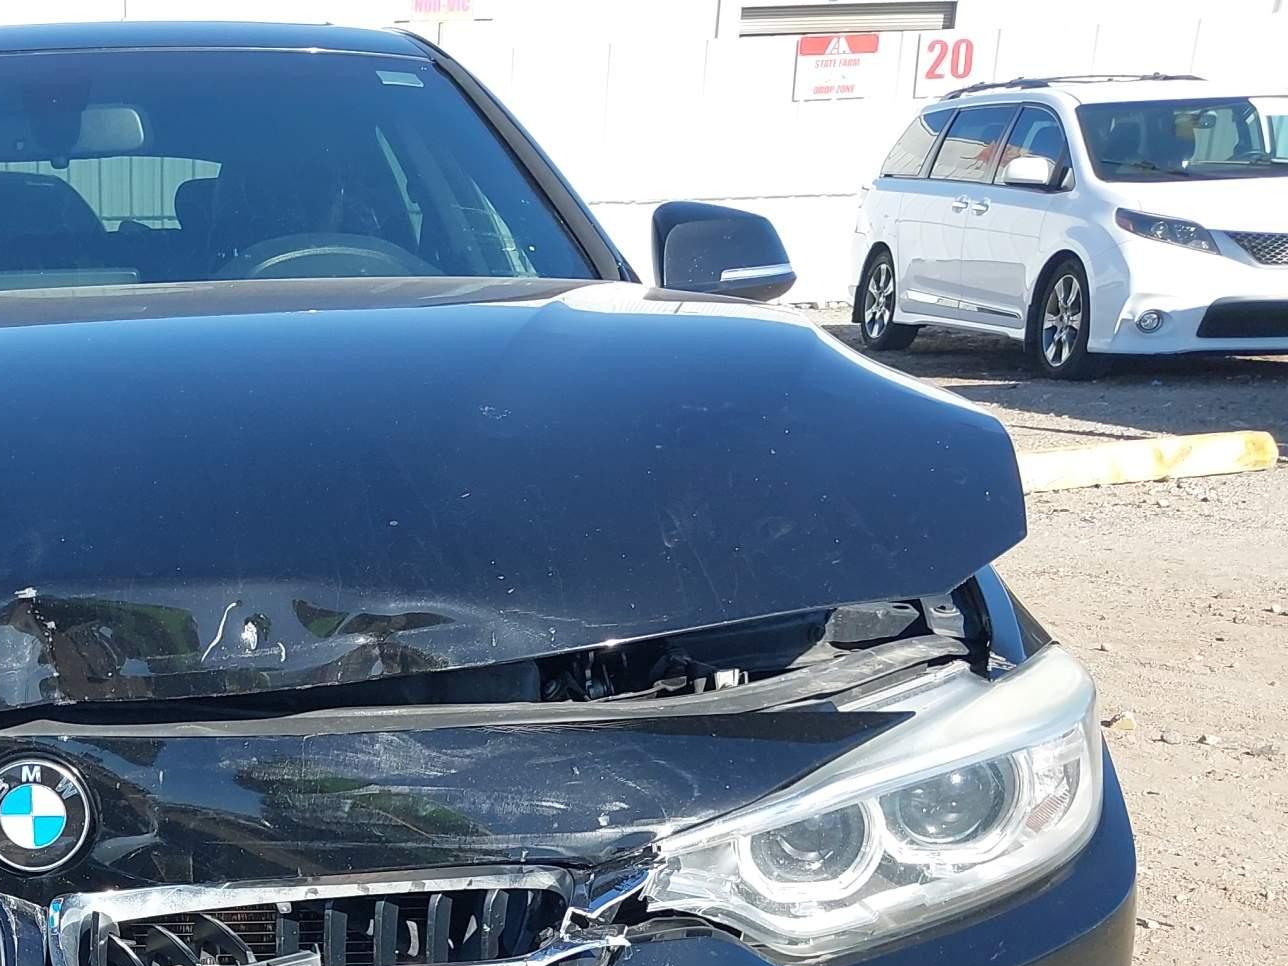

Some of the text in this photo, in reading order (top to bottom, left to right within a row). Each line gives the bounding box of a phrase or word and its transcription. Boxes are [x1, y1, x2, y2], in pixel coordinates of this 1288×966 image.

[925, 38, 974, 79] 20
[812, 84, 856, 95] DROP ZONE
